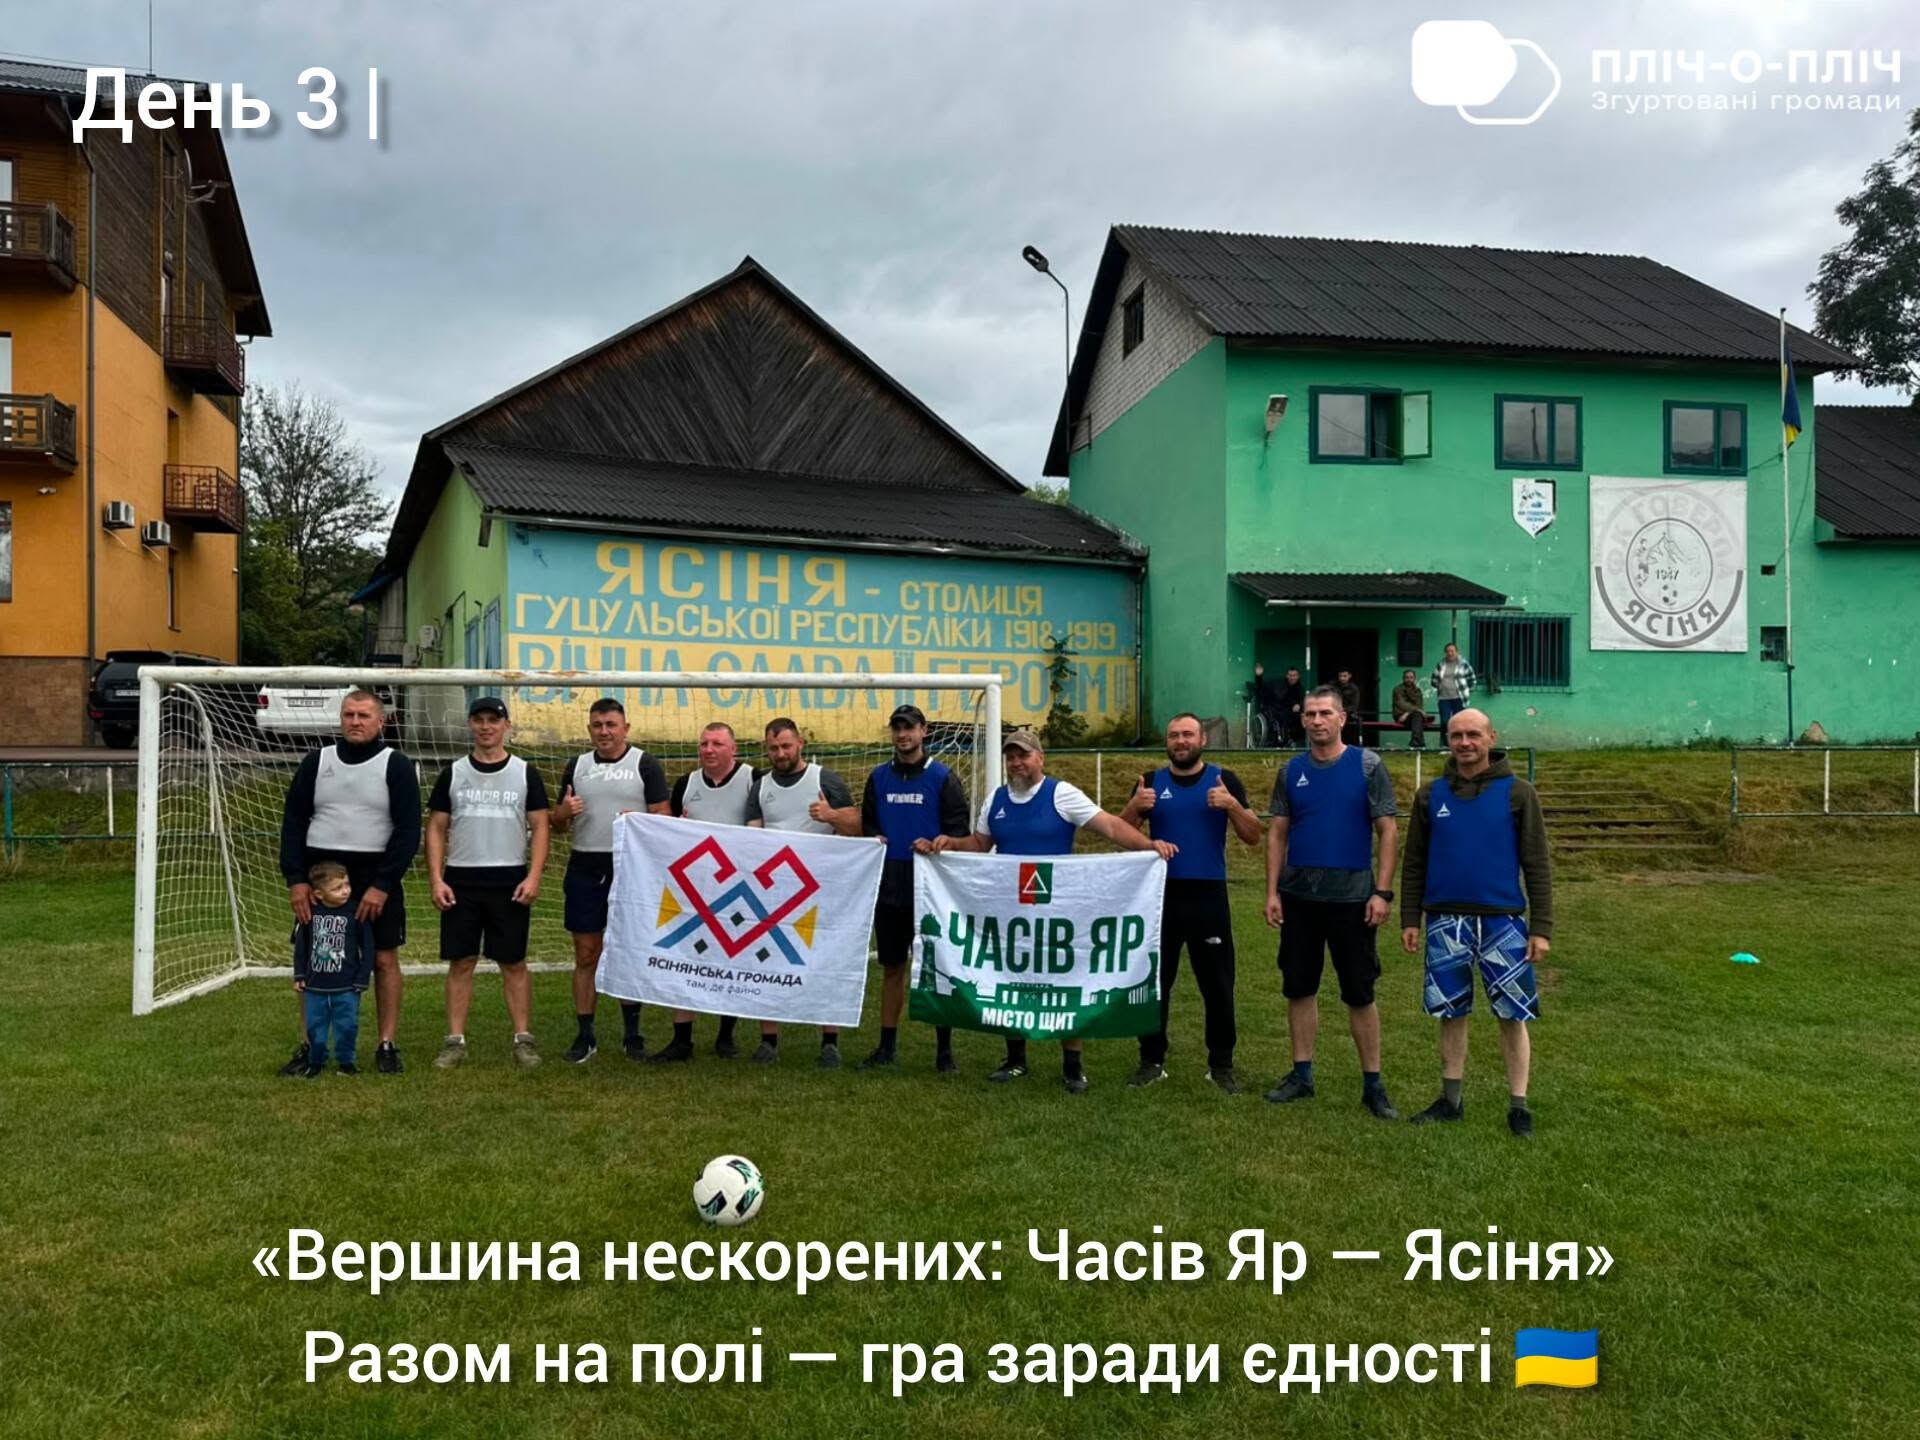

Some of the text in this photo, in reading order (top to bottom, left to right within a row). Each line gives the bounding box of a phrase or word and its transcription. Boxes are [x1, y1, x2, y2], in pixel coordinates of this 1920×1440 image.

[596, 541, 846, 608] ЯСІНЯ
[900, 580, 1043, 618] СТОЛИЦЯ
[515, 593, 781, 641] ГУЦУЛЬСЬКОЇ
[790, 610, 992, 649] РЕСПУБЛІКИ
[1623, 599, 1720, 636] ЯСІНЯ
[949, 911, 1145, 974] ЧАСІВ ЯР
[648, 957, 803, 987] ЯСІНЯНСЬКА ГРОМАДА
[981, 1007, 1077, 1032] МІСТО ЩИТ
